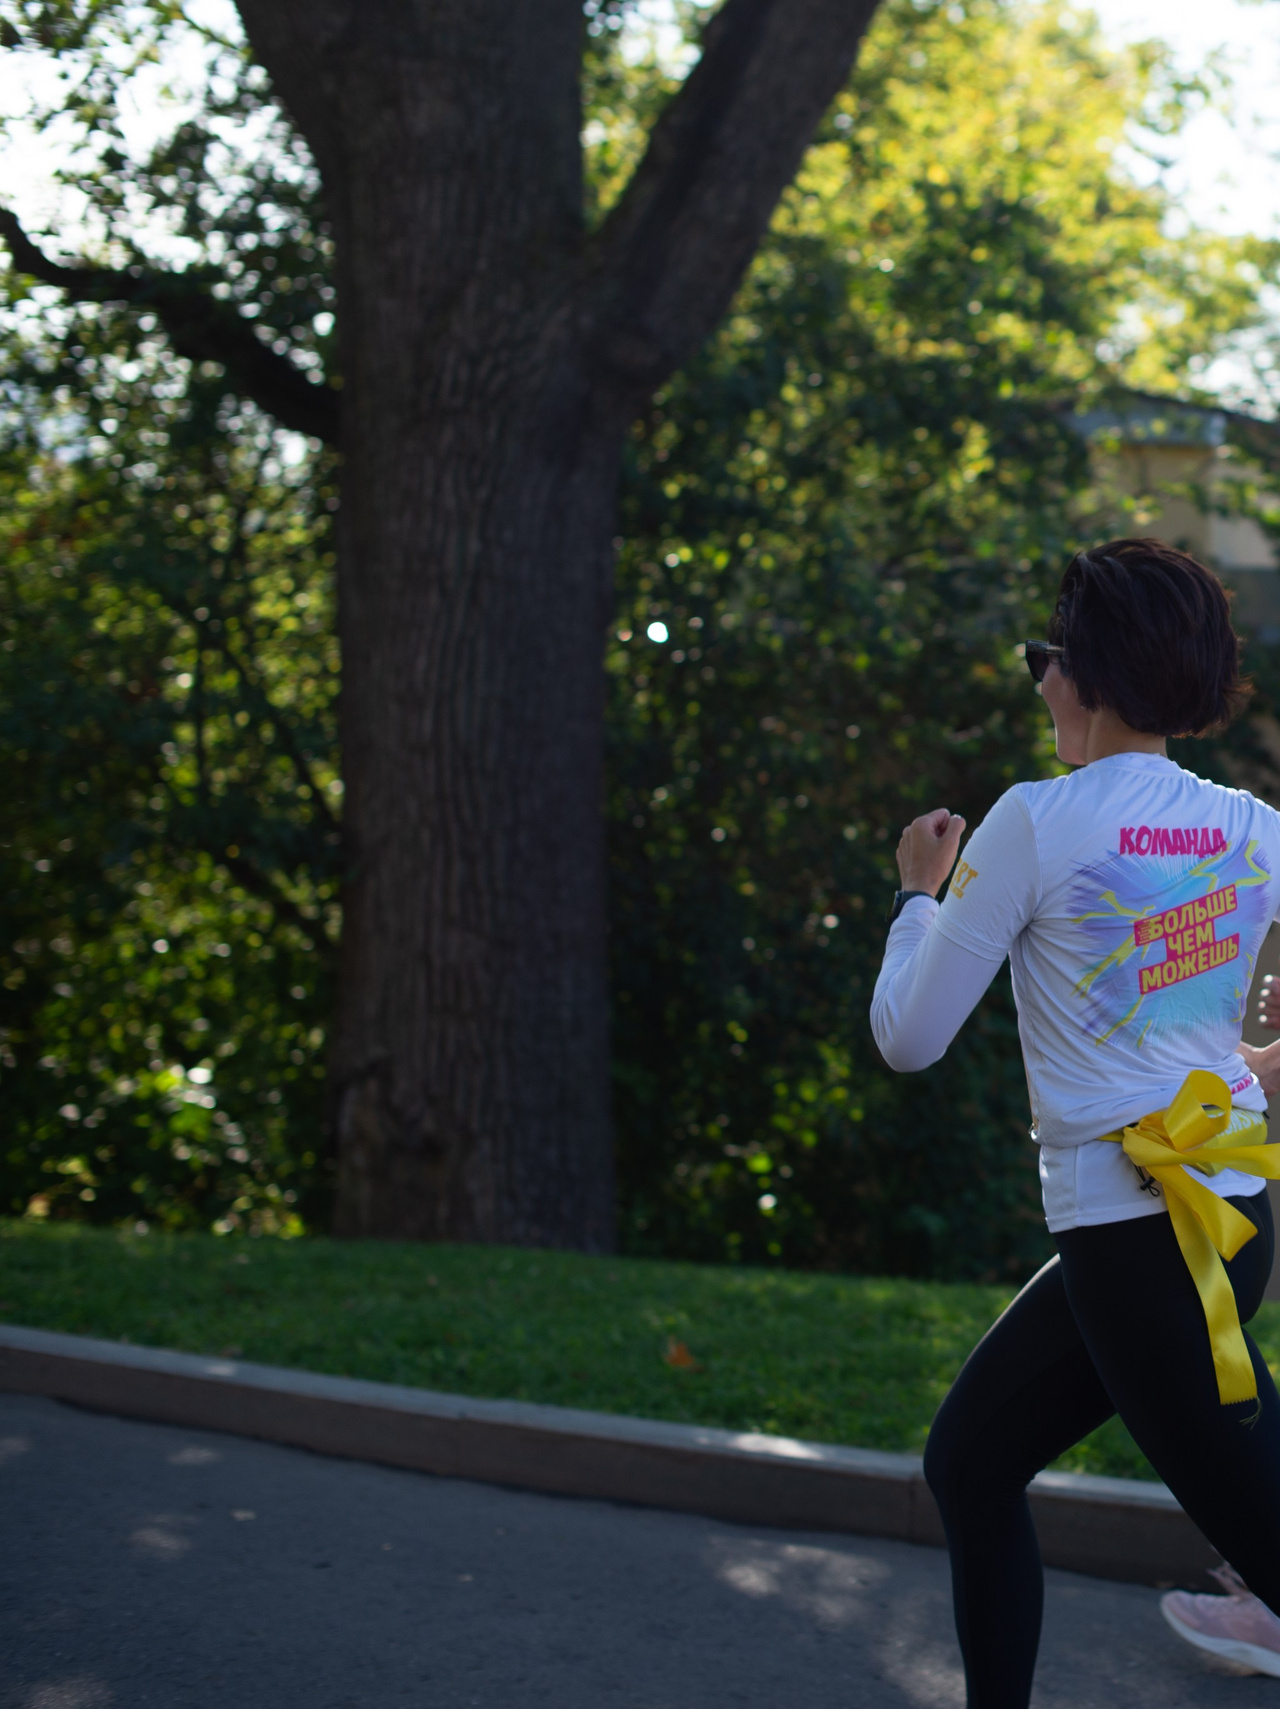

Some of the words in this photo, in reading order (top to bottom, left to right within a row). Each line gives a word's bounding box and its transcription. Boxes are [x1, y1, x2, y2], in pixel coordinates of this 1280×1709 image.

[1119, 825, 1228, 858] КОМАНДА
[1148, 886, 1237, 941] БОЛЬШЕ
[1167, 920, 1214, 956] ЧЕМ
[1141, 937, 1239, 993] МОЖЕШЬ
